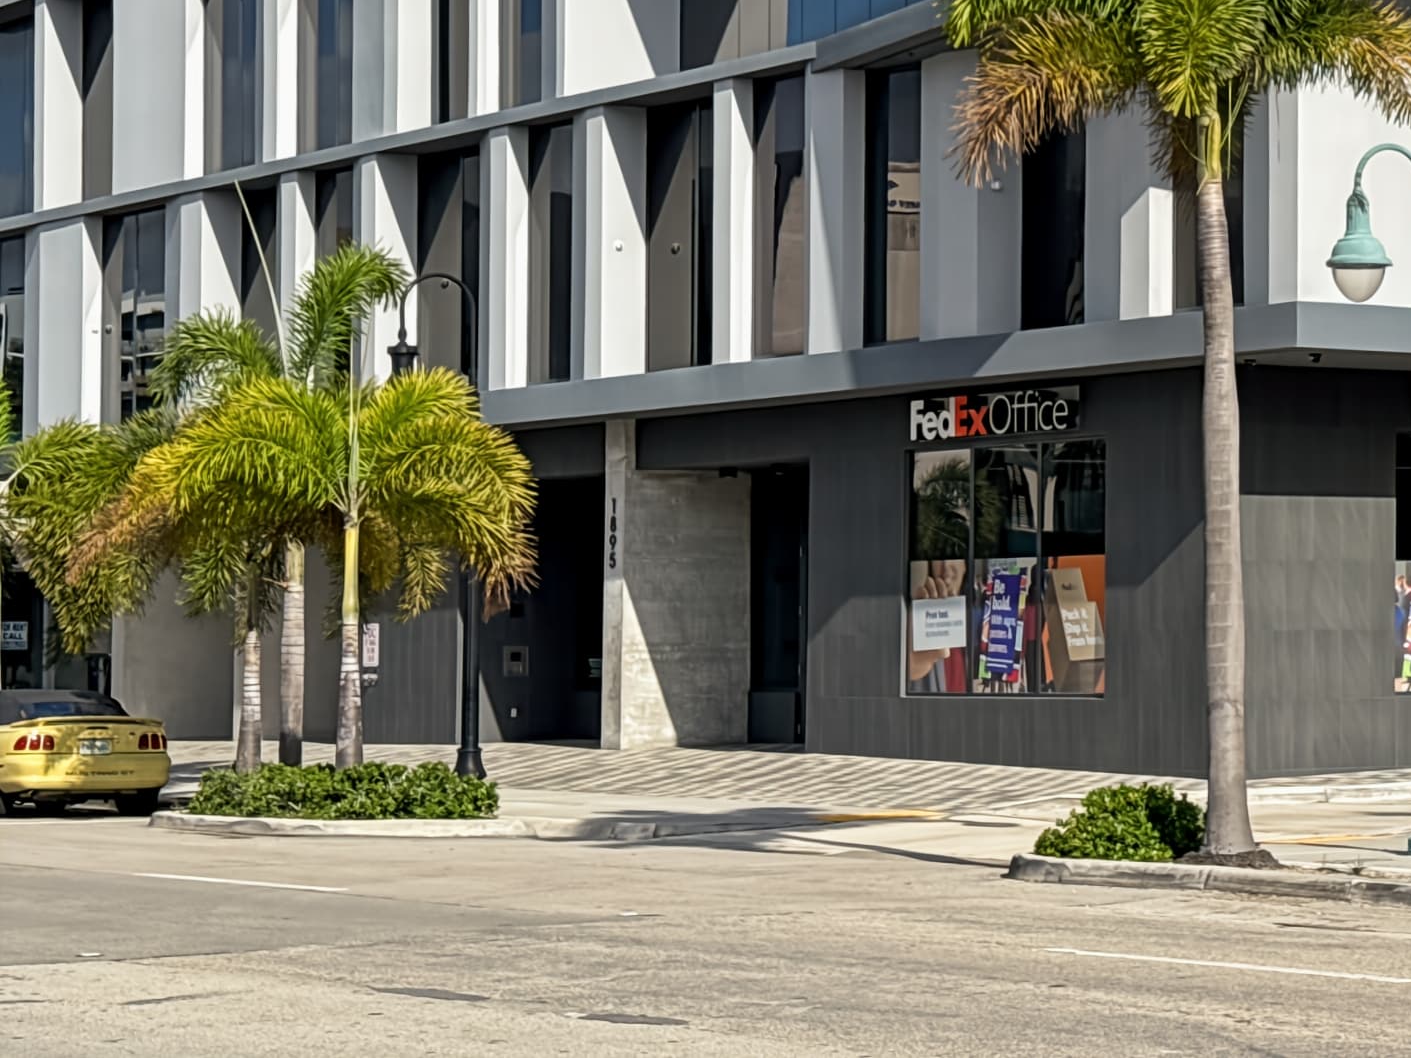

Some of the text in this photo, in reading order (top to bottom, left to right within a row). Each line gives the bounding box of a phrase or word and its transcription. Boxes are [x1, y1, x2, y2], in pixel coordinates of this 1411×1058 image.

[910, 390, 1069, 441] FedEx Office
[609, 497, 617, 569] 1895
